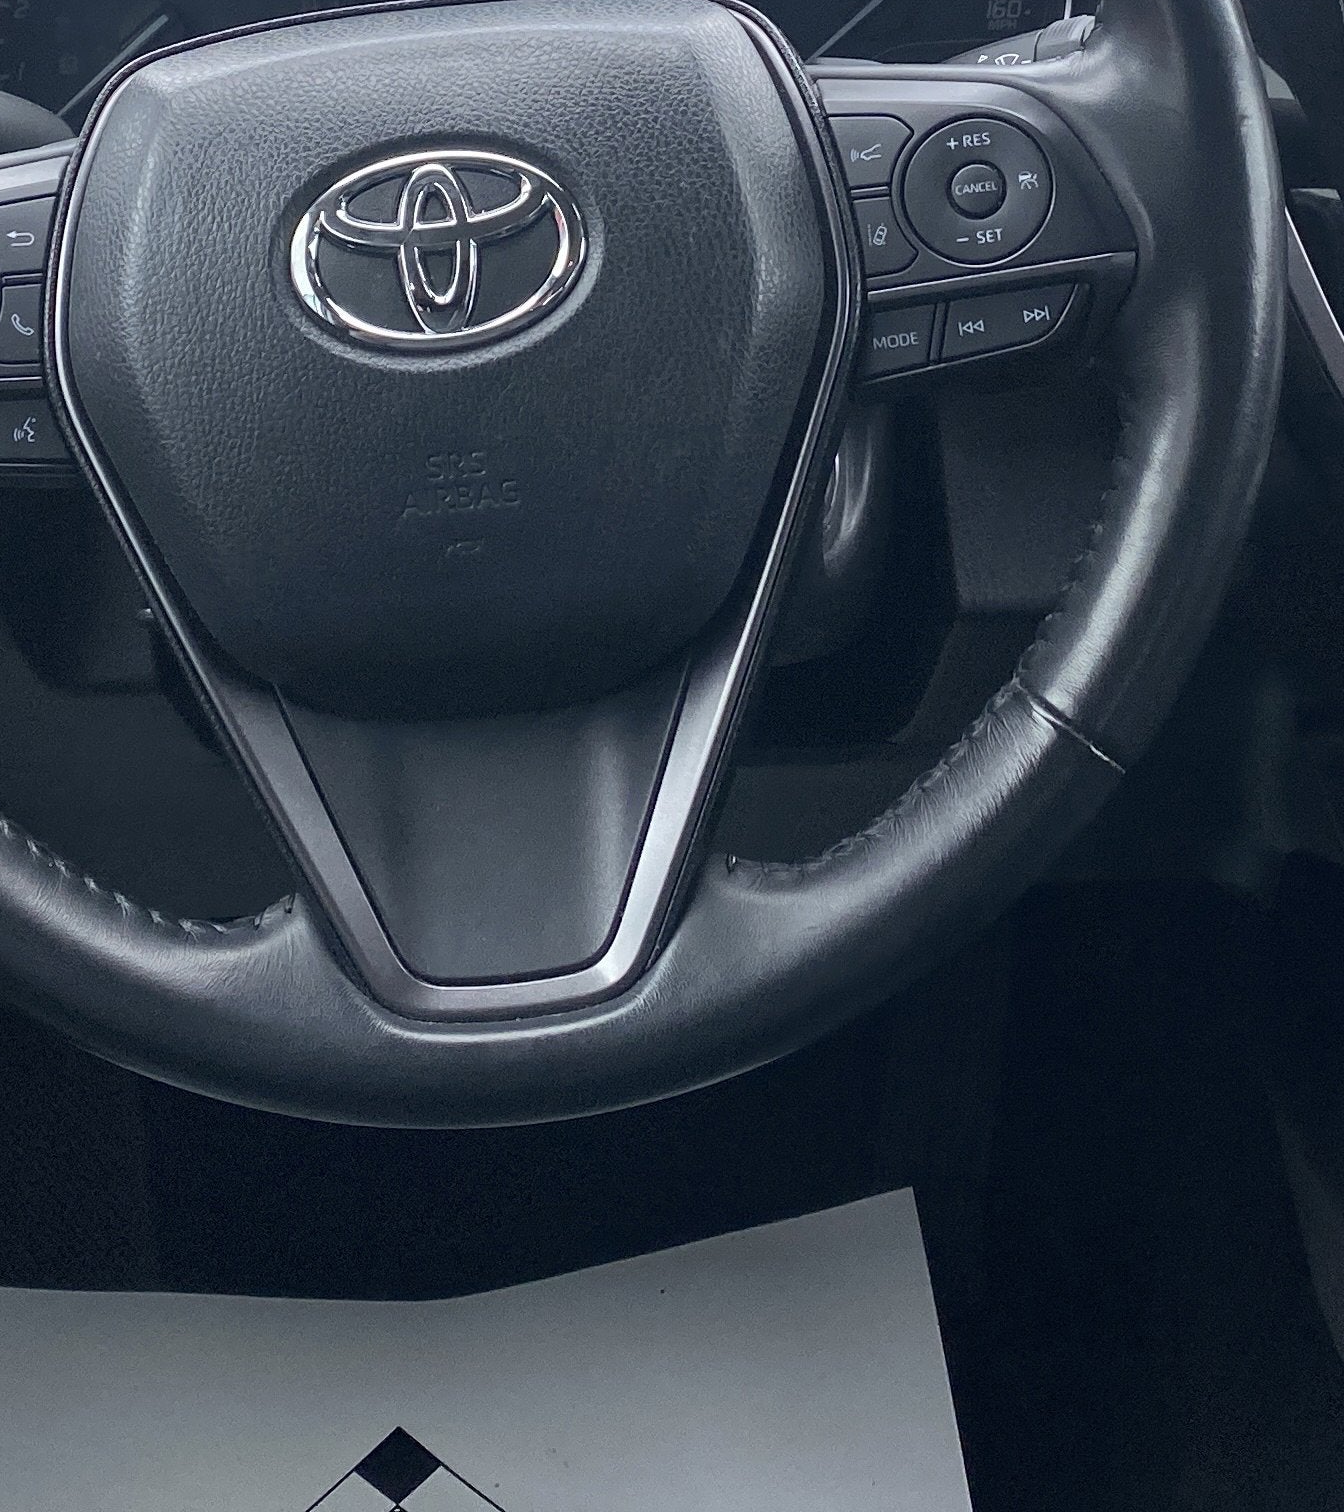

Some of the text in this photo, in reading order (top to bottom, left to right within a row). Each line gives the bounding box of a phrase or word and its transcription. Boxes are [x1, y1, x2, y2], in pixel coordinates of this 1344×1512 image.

[987, 18, 1018, 30] MPH
[962, 132, 991, 148] RES
[955, 181, 997, 195] CANCEL
[976, 228, 1003, 244] SET
[873, 331, 919, 350] MODE
